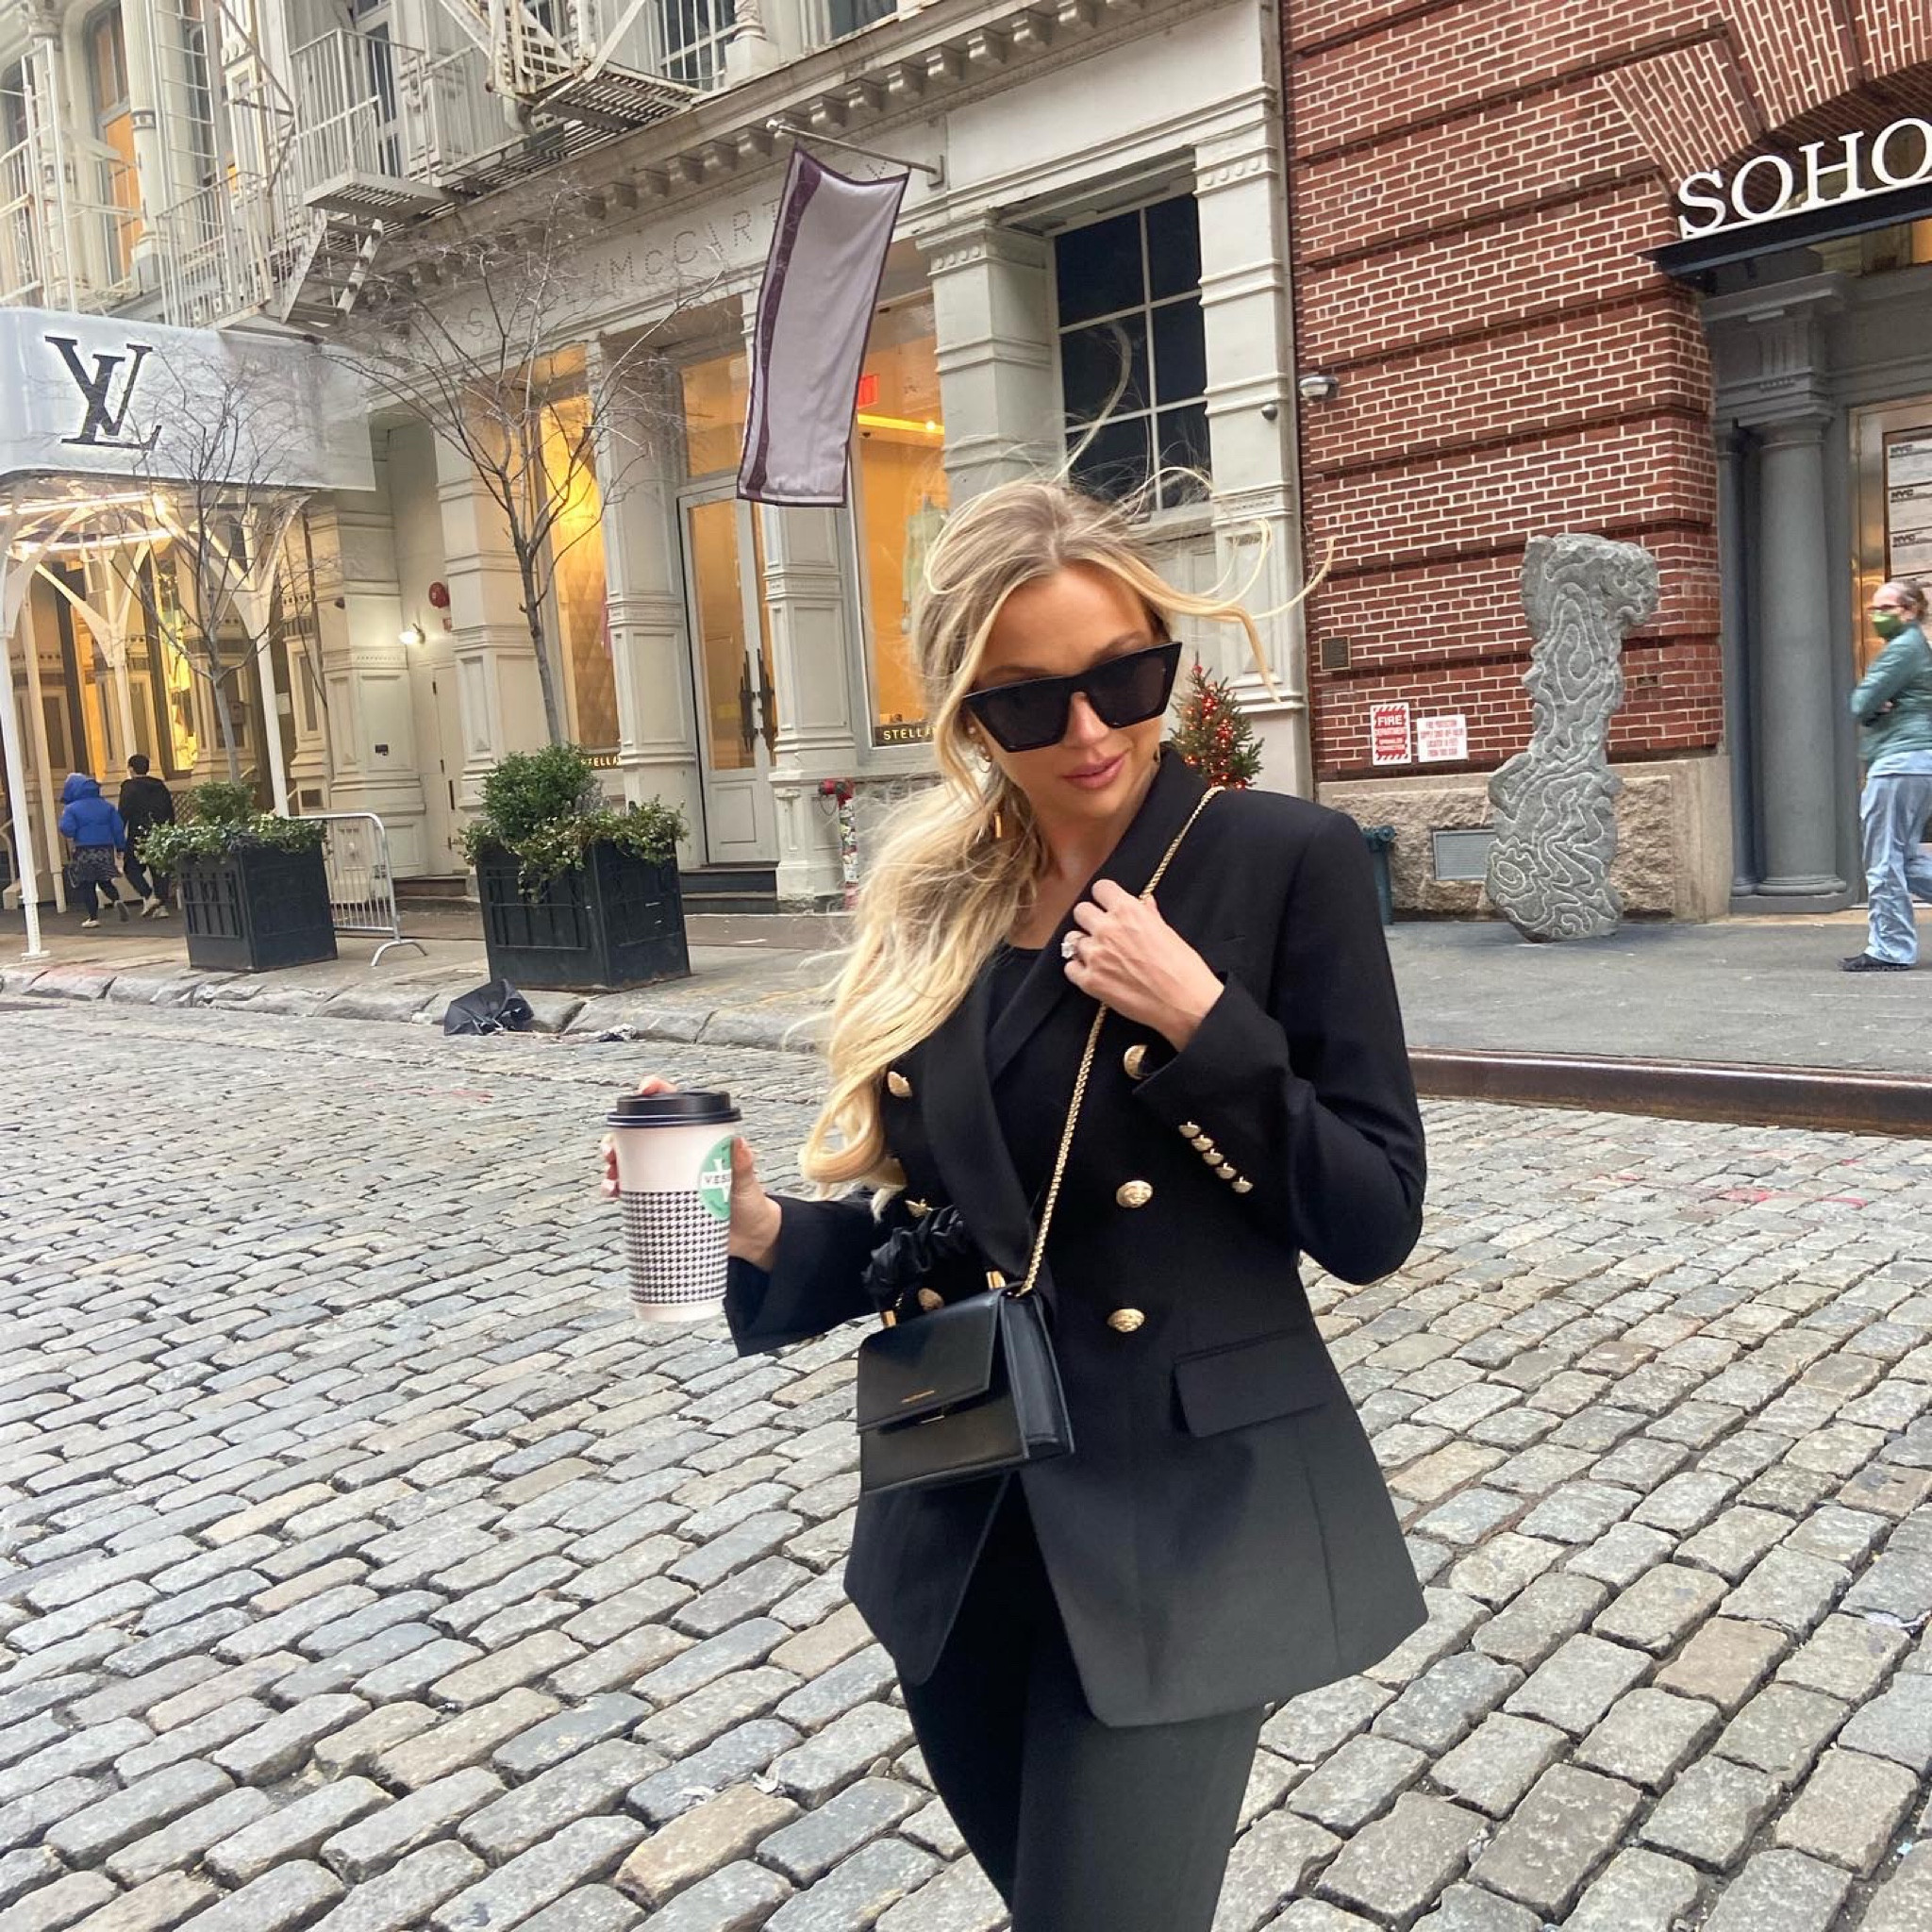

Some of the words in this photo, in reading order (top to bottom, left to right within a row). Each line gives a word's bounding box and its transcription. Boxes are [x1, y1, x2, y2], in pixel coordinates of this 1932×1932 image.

[1677, 118, 1932, 240] SOHO
[1377, 714, 1403, 726] FIRE
[704, 1174, 731, 1184] VES
